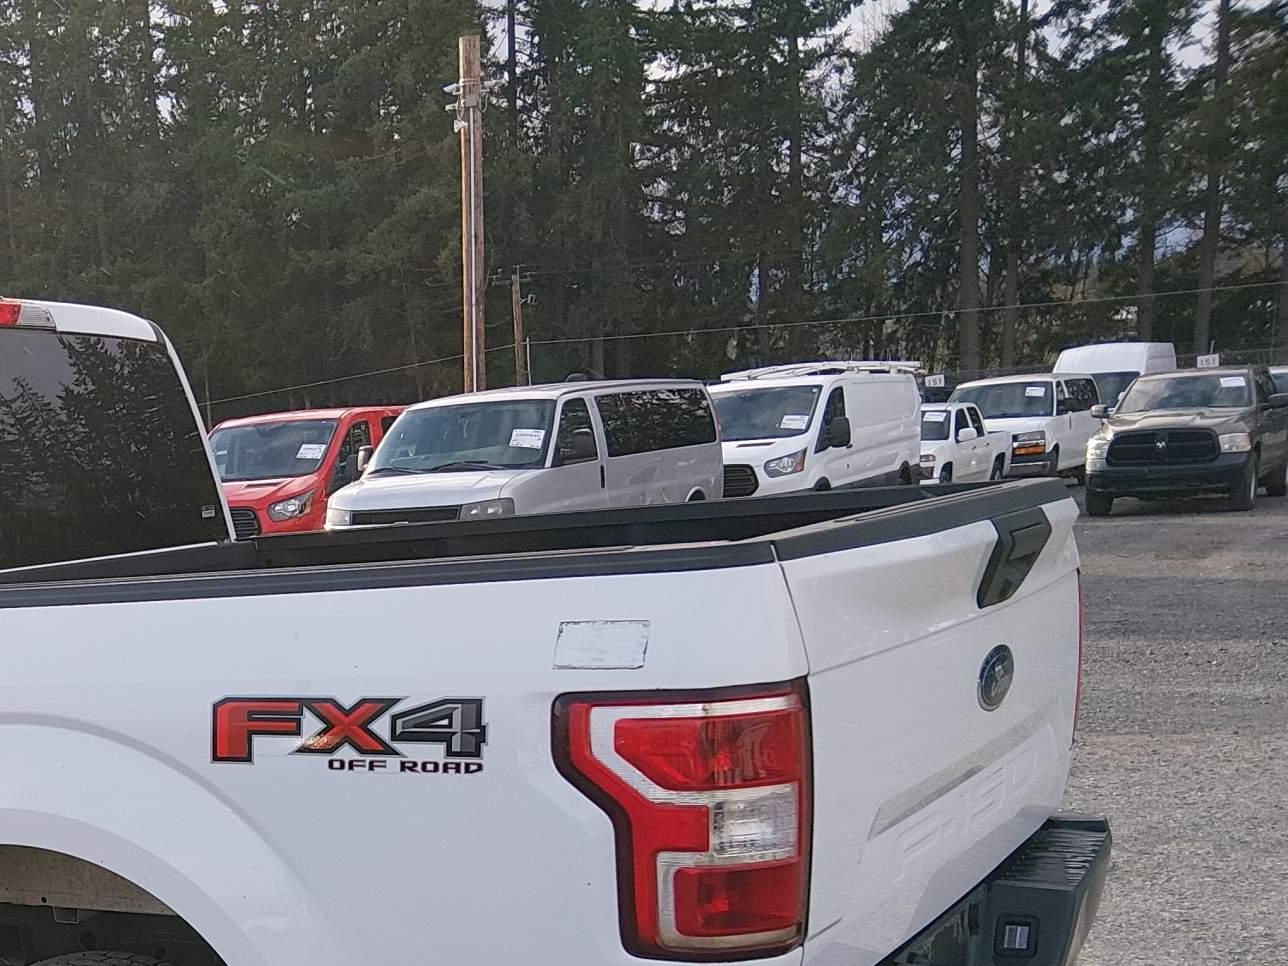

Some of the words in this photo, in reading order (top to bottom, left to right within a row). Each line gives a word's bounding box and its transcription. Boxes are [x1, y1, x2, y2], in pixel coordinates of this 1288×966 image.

[212, 697, 488, 765] FX4
[328, 759, 387, 772] OFF
[400, 761, 484, 775] ROAD
